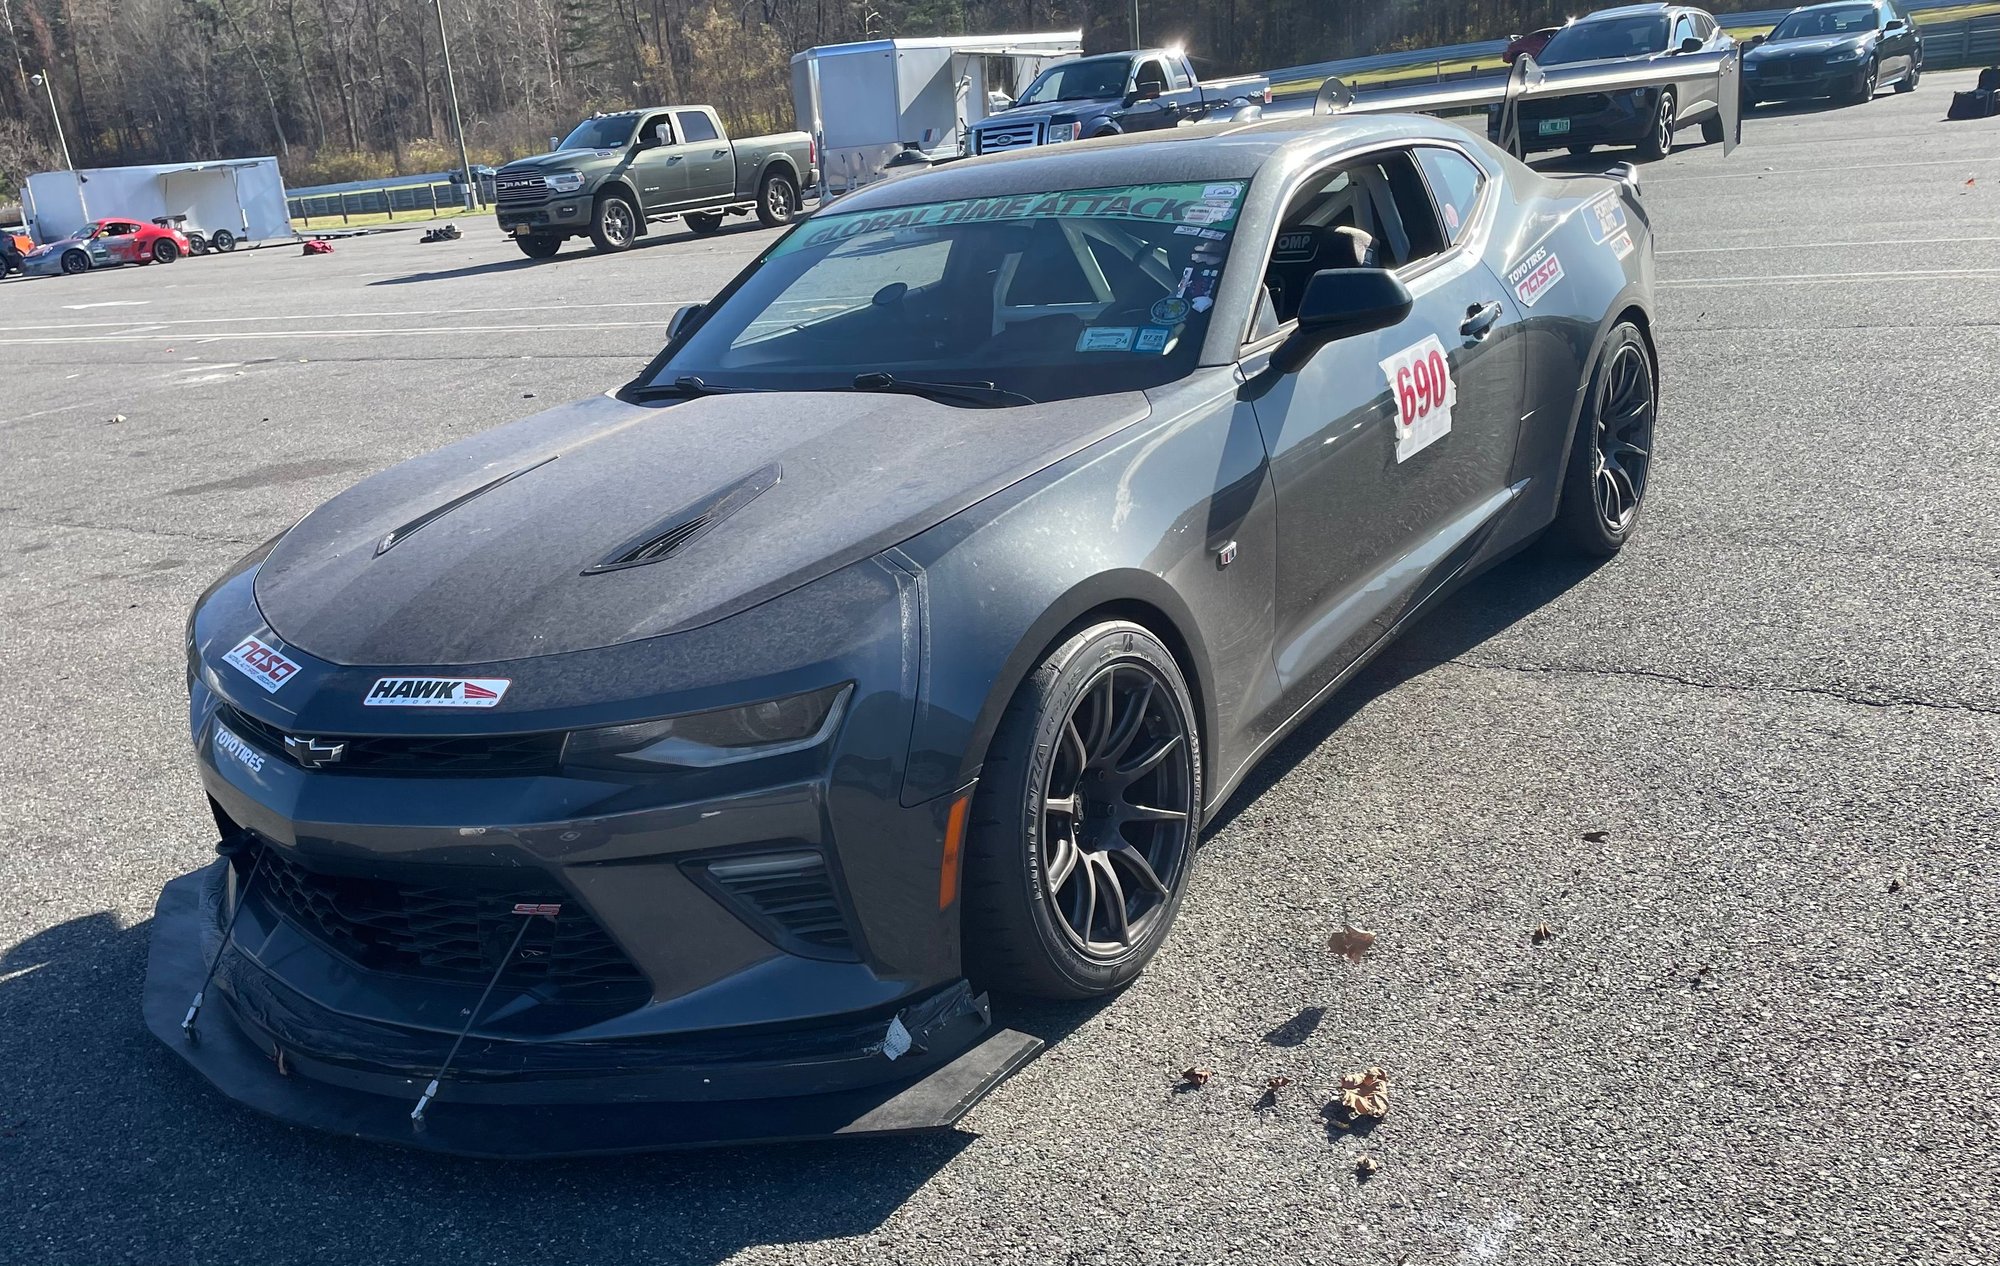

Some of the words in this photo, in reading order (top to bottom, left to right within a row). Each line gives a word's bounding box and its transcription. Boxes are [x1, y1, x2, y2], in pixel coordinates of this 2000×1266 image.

[803, 208, 930, 248] GLOBAL
[936, 196, 1035, 224] TIME
[1027, 196, 1202, 221] ATTACK
[1277, 235, 1311, 250] OMP
[1397, 349, 1446, 426] 690
[370, 680, 463, 699] HAWK
[214, 727, 240, 753] TOYO
[234, 743, 266, 773] TIRES
[511, 903, 562, 915] SS
